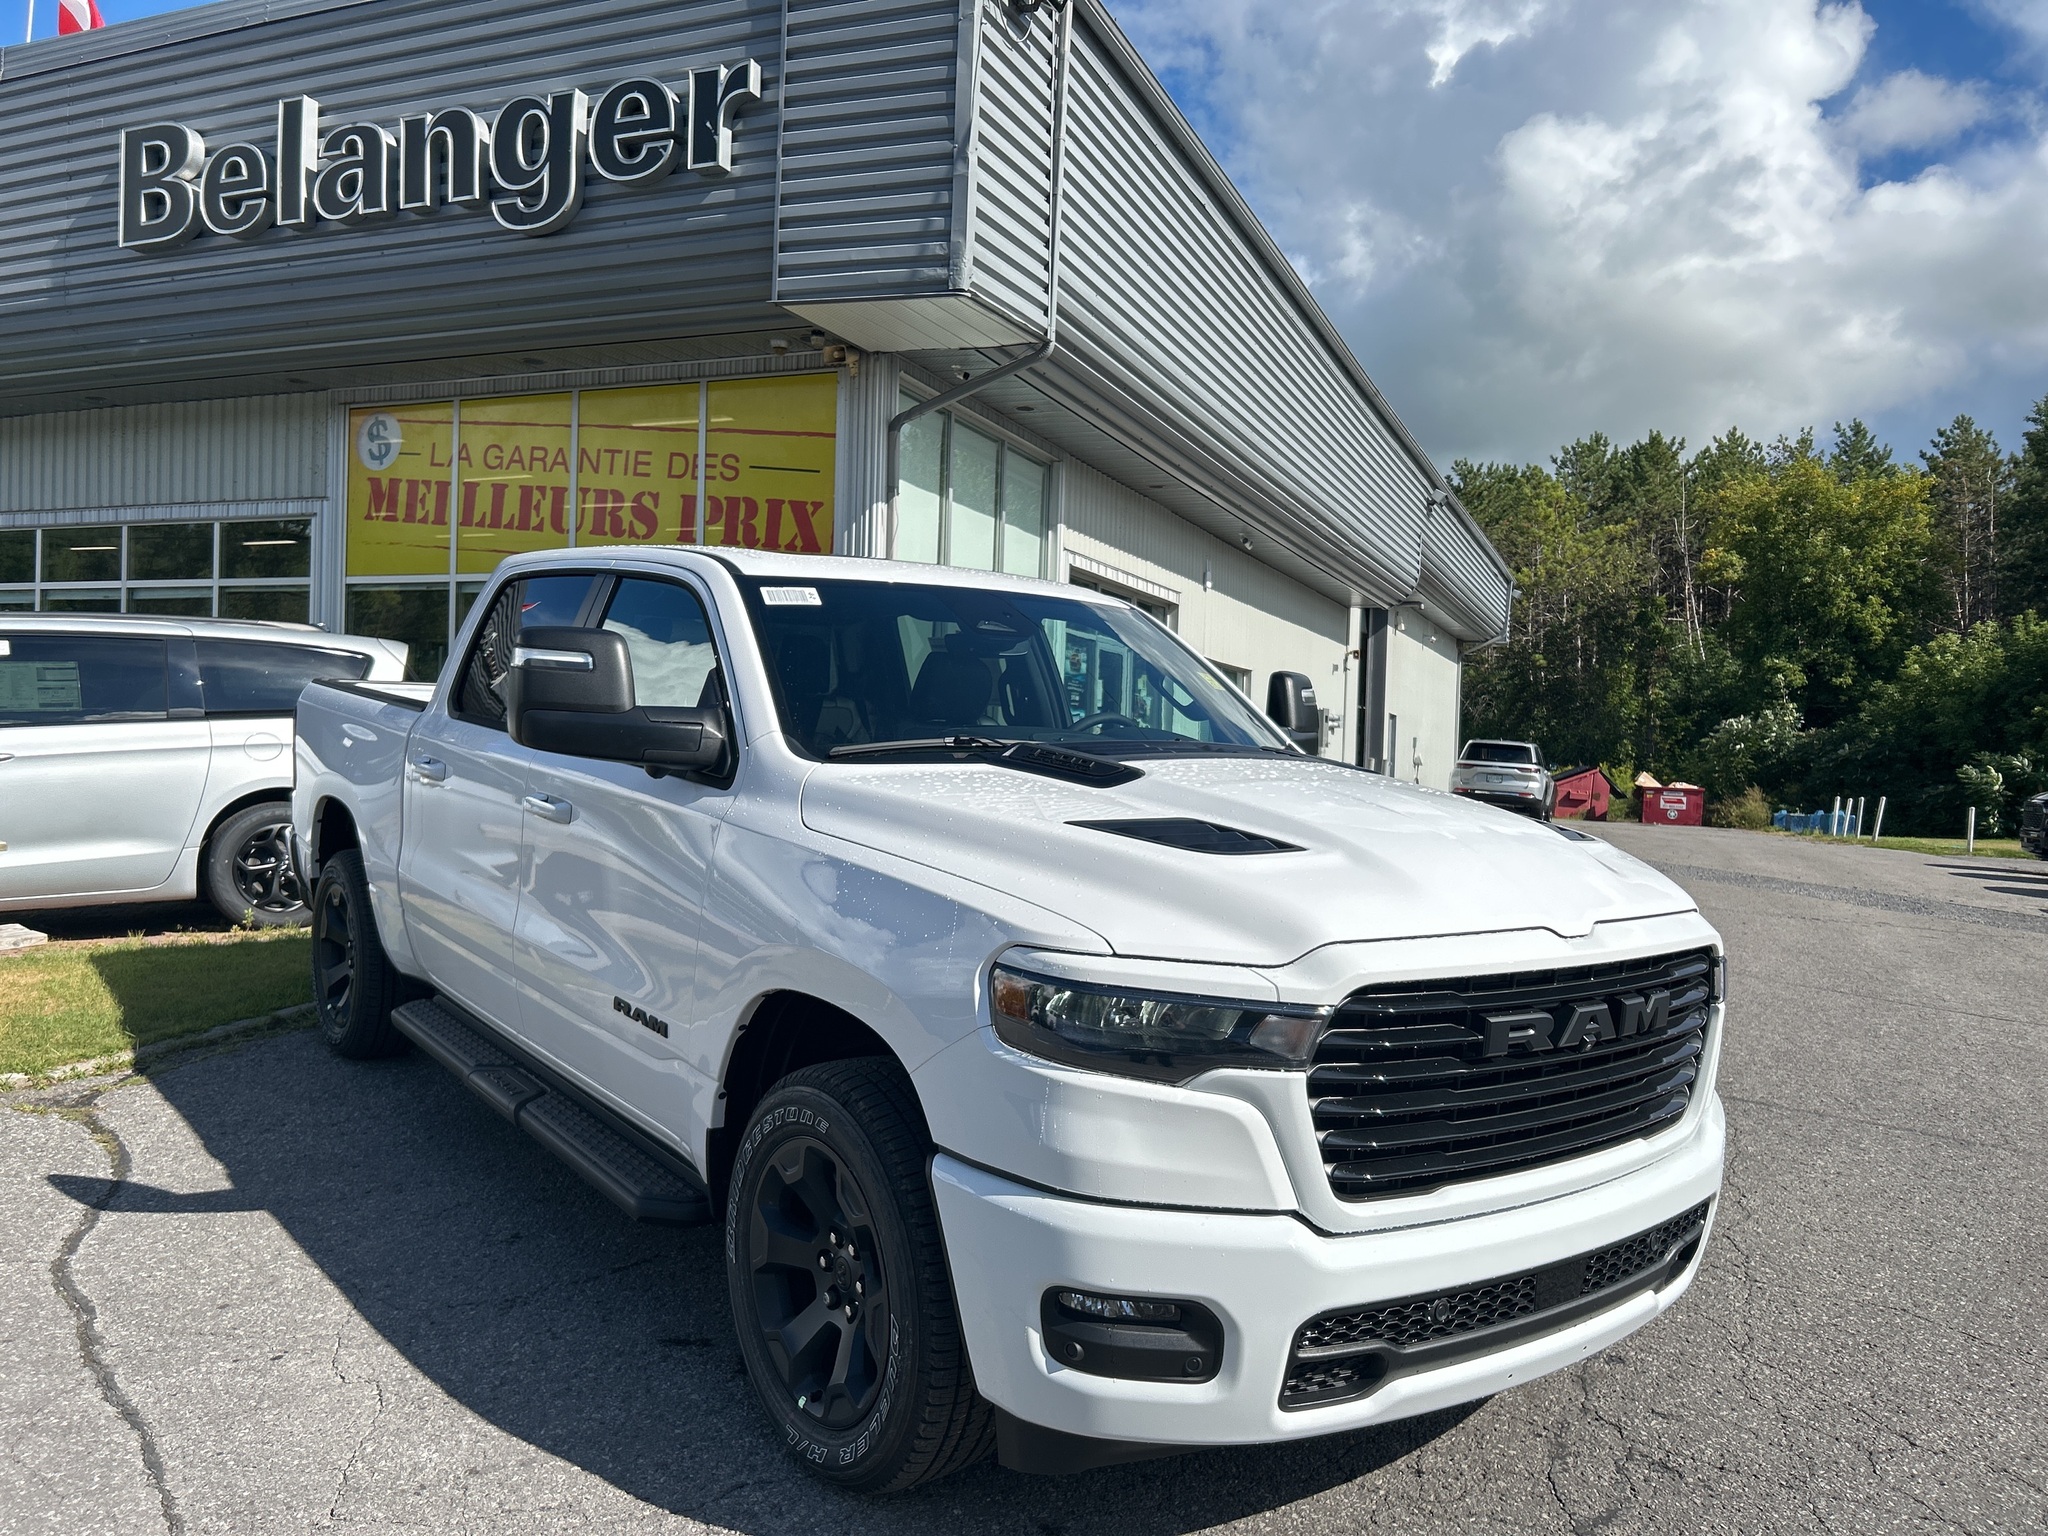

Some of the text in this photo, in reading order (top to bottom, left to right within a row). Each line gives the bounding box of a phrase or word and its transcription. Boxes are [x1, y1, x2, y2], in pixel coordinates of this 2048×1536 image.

[118, 58, 761, 250] Belanger
[430, 441, 741, 482] LA GARANTIE DES
[364, 476, 825, 554] MEILLEURS PRIX
[613, 995, 669, 1039] RAM
[1483, 988, 1670, 1058] RAM
[726, 1106, 830, 1264] BRIDGESTONE
[785, 1313, 899, 1465] DUELER H/L
